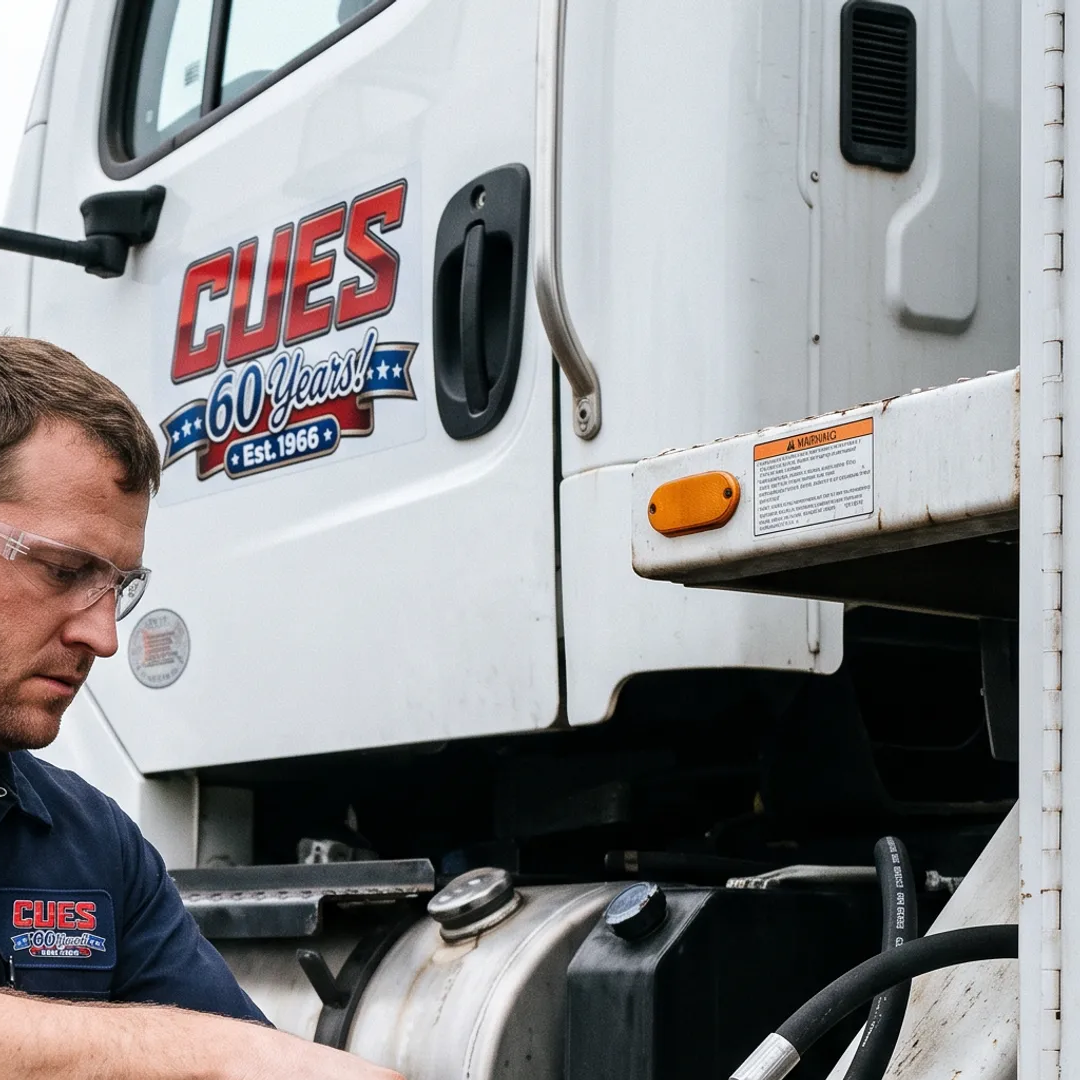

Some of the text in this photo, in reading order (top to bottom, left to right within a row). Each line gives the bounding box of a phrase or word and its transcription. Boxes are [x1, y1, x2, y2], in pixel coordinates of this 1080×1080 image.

[171, 178, 408, 385] CUES
[207, 327, 378, 442] 60 Years!
[242, 425, 320, 467] Est. 1966
[12, 899, 97, 931] CUES
